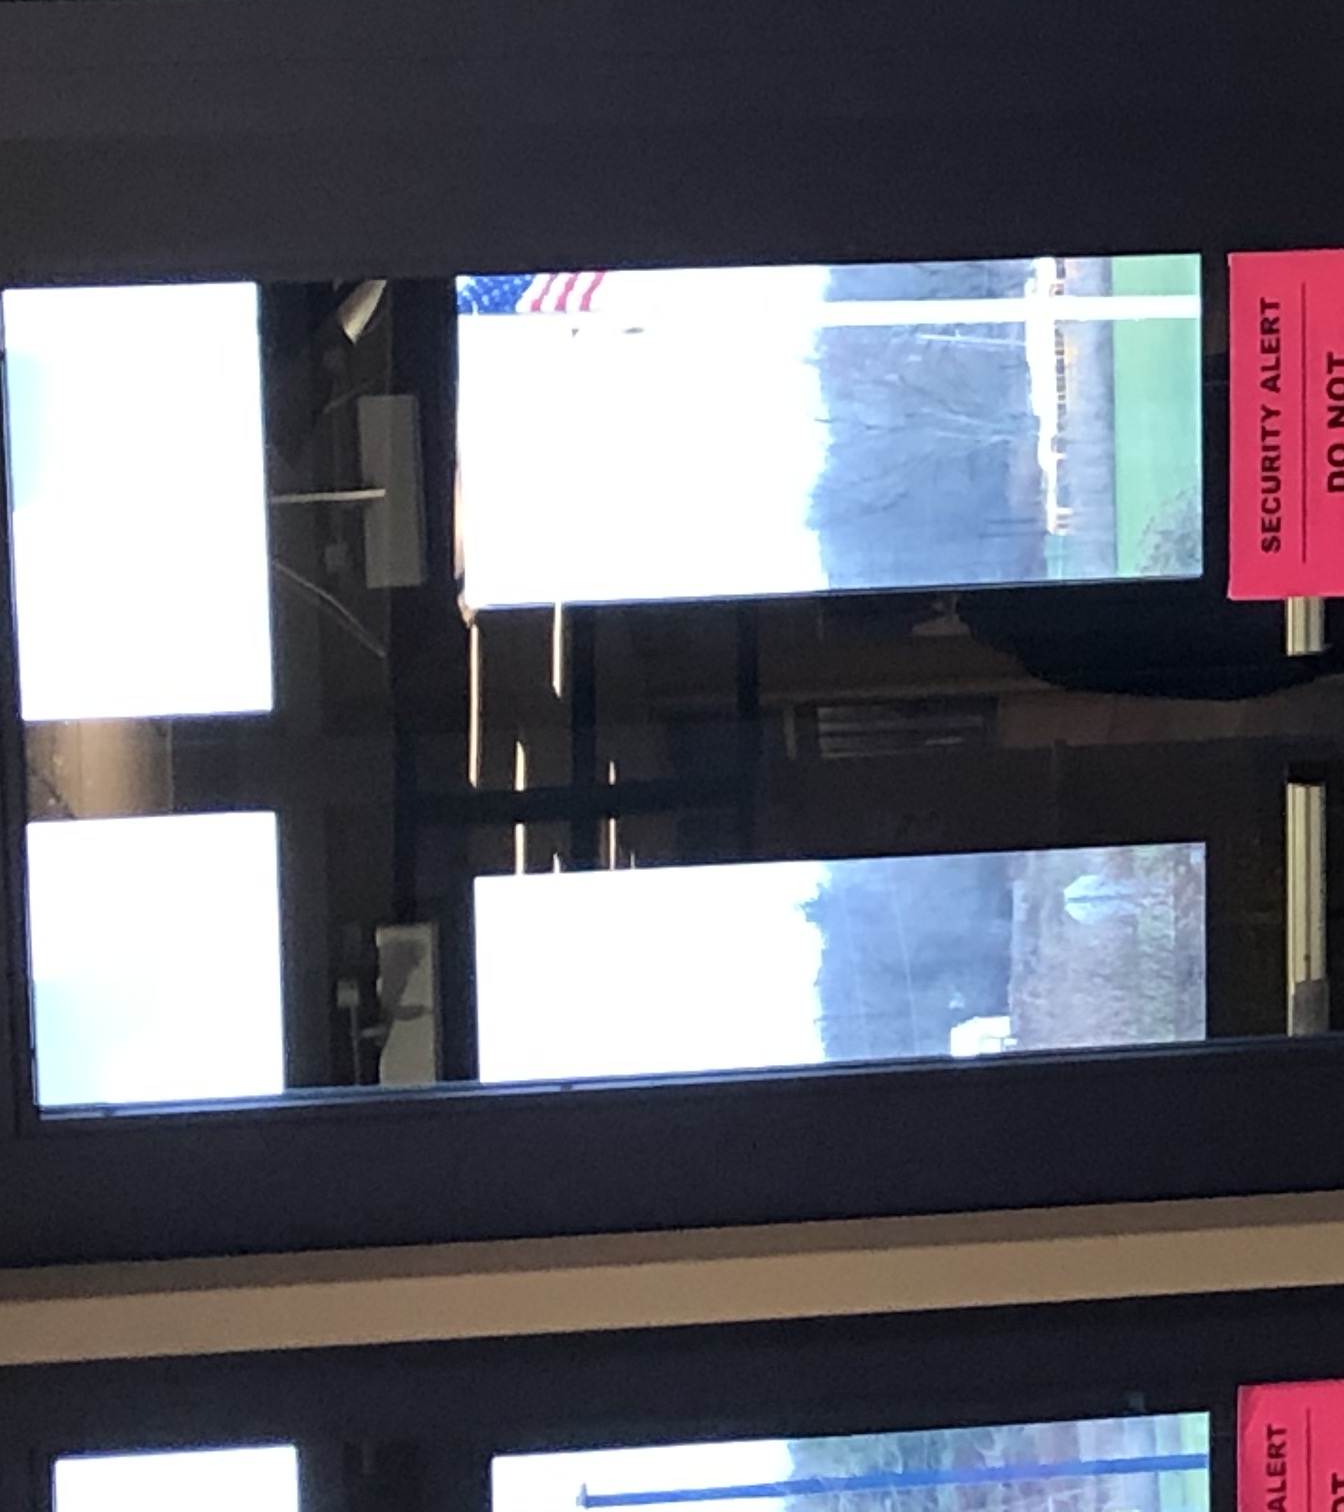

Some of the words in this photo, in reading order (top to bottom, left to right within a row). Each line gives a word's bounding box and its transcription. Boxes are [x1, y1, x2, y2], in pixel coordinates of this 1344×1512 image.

[1259, 297, 1281, 393] ALERT
[1260, 405, 1282, 554] SECURITY
[1266, 1424, 1287, 1512] ALERT
